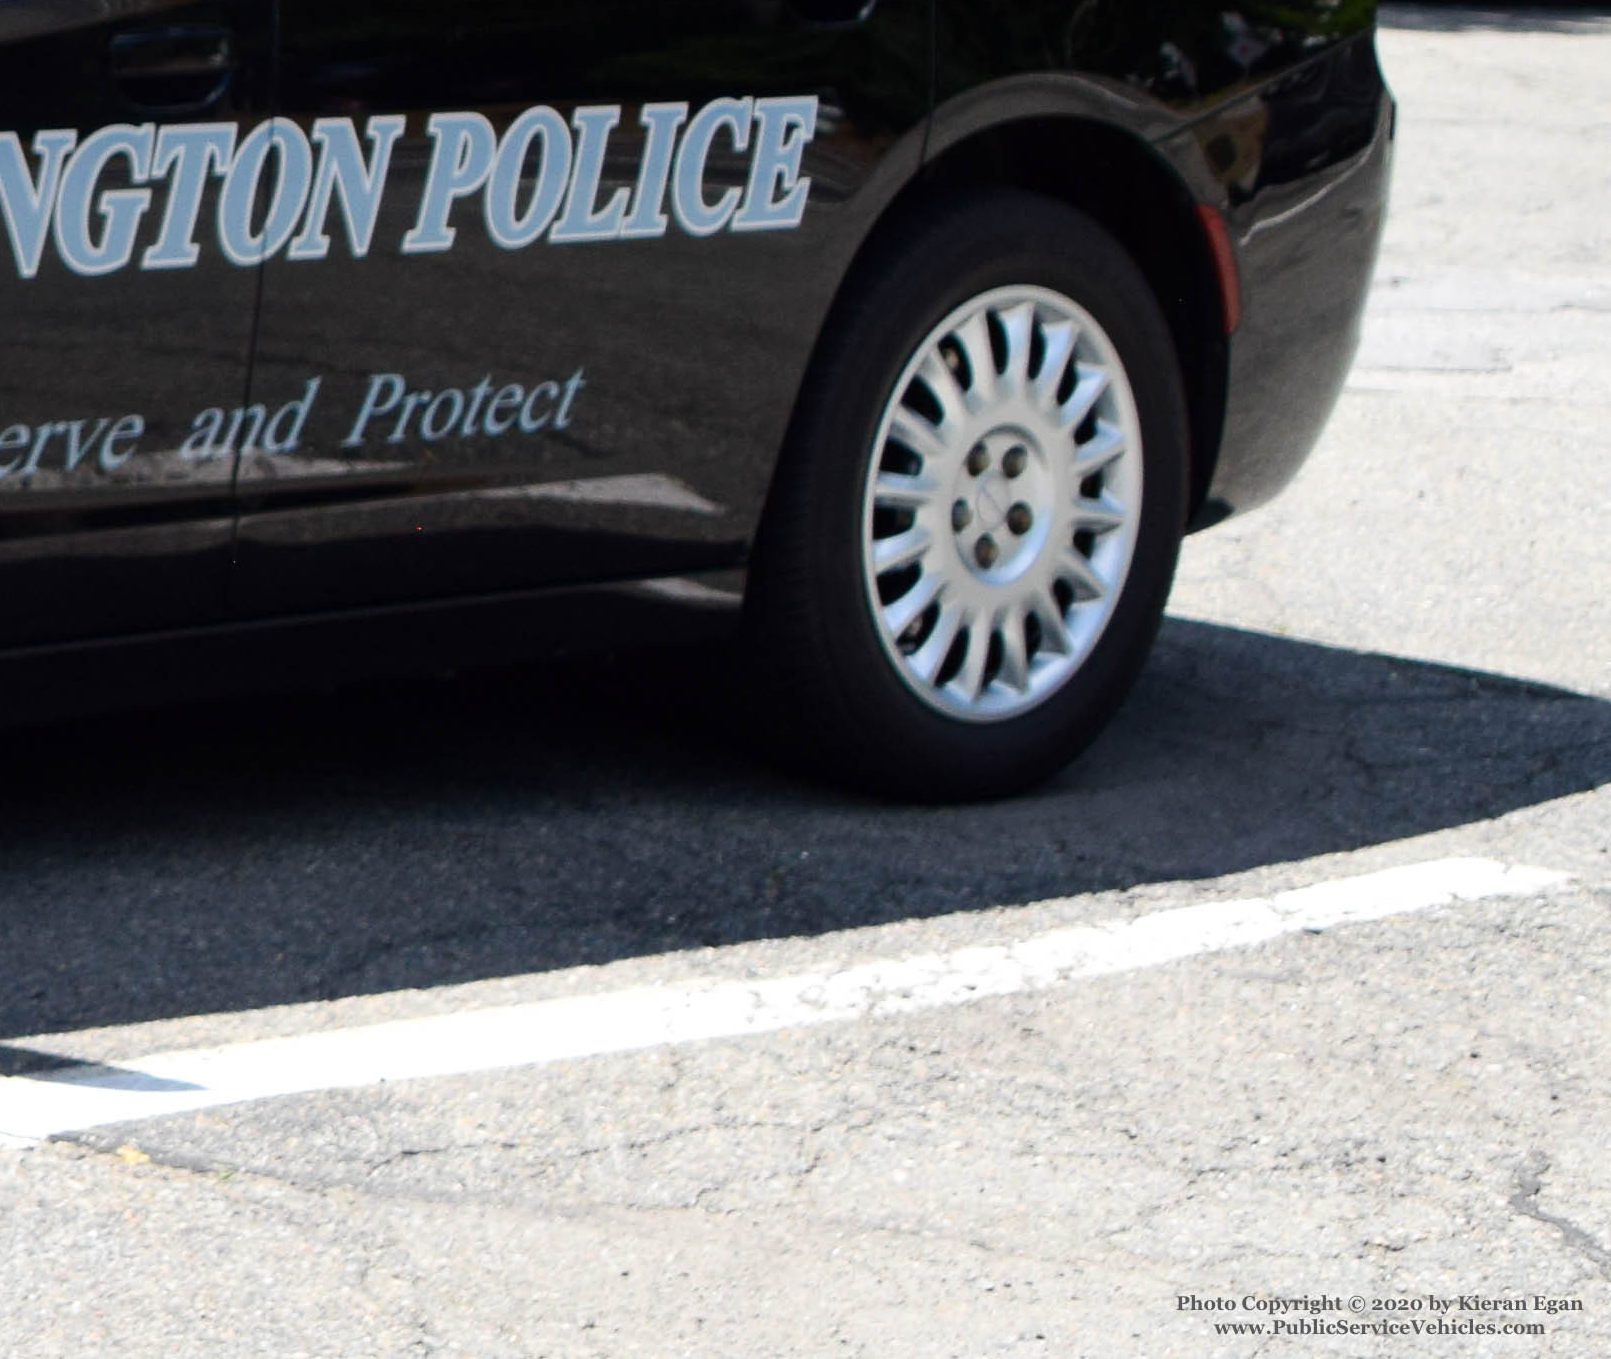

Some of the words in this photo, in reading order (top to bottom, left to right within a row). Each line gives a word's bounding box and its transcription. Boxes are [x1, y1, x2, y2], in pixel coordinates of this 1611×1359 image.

[400, 94, 820, 254] POLICE
[180, 374, 322, 461] and
[341, 366, 586, 449] Protect
